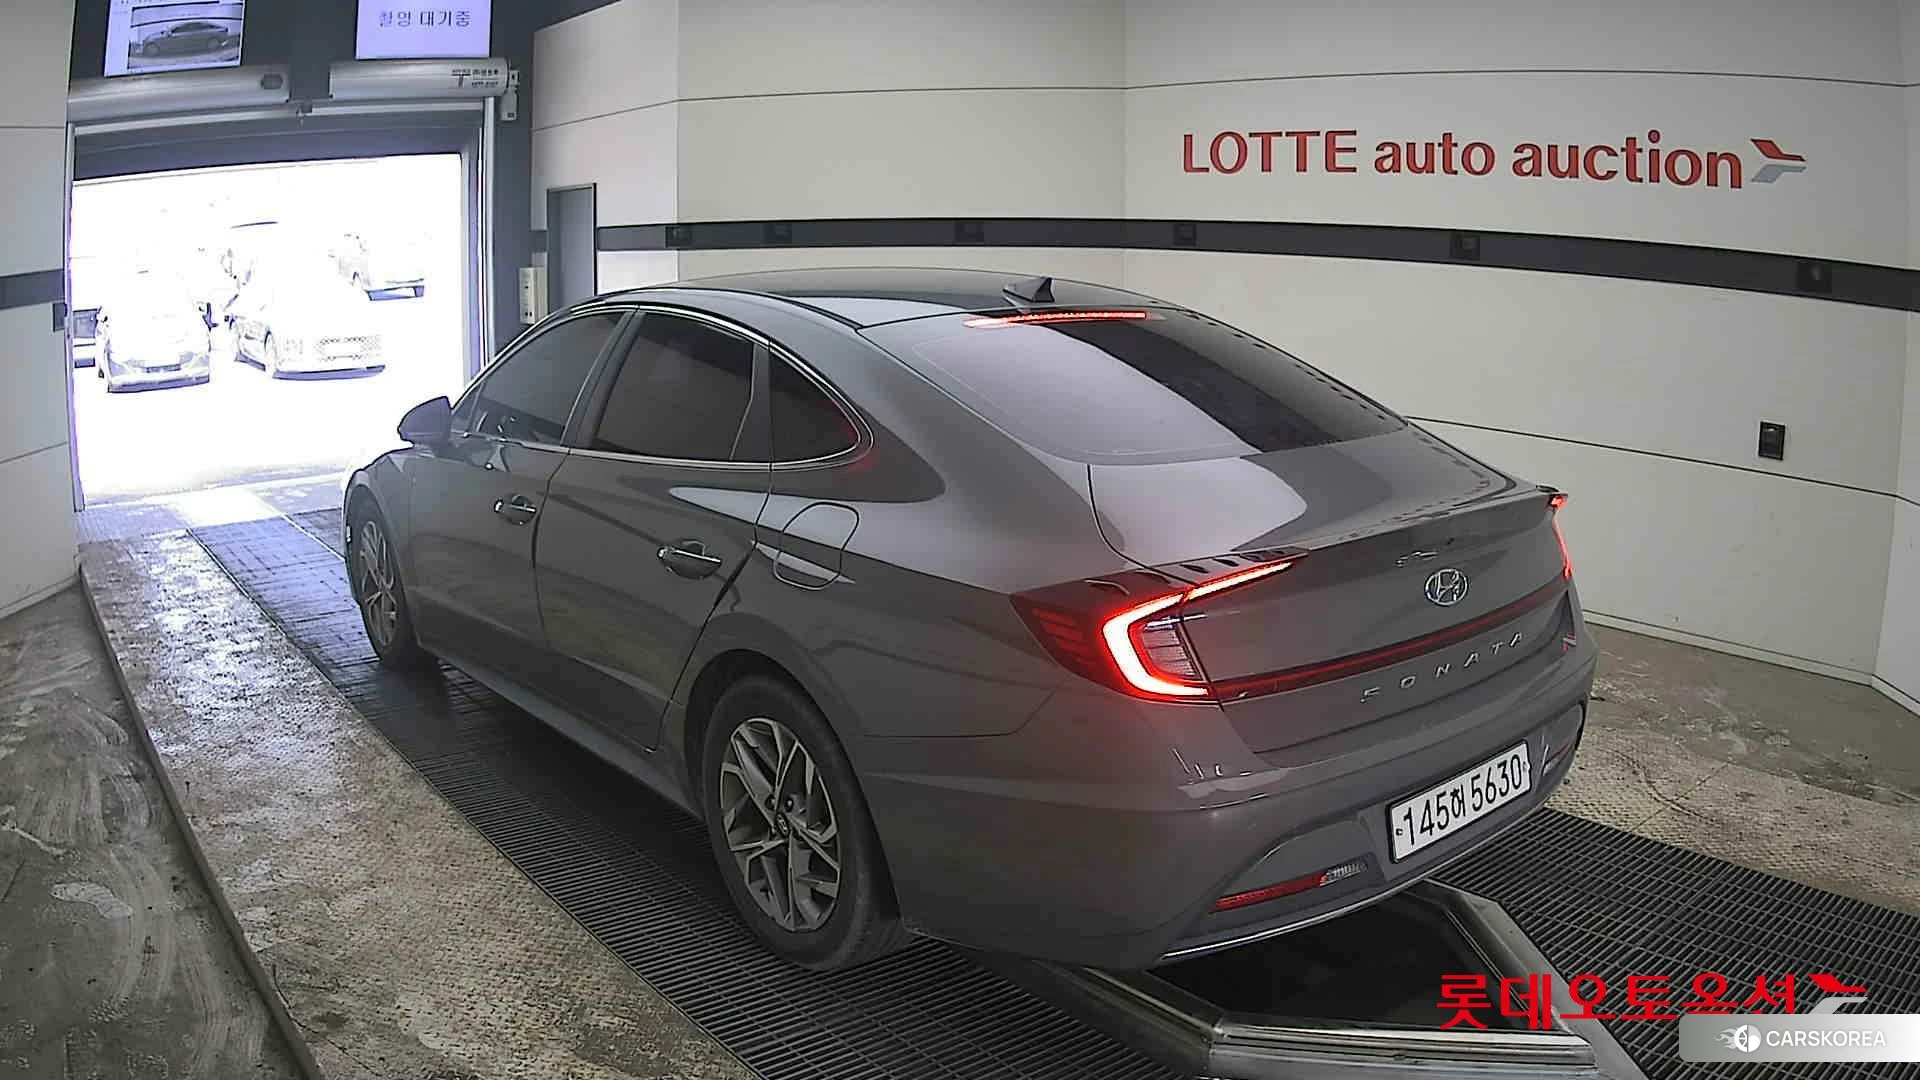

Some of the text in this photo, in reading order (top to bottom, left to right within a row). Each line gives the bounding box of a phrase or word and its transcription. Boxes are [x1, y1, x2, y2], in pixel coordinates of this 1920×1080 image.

[420, 10, 471, 27] 대기중
[1183, 129, 1743, 190] LOTTE auto auction
[1471, 754, 1522, 812] 5630
